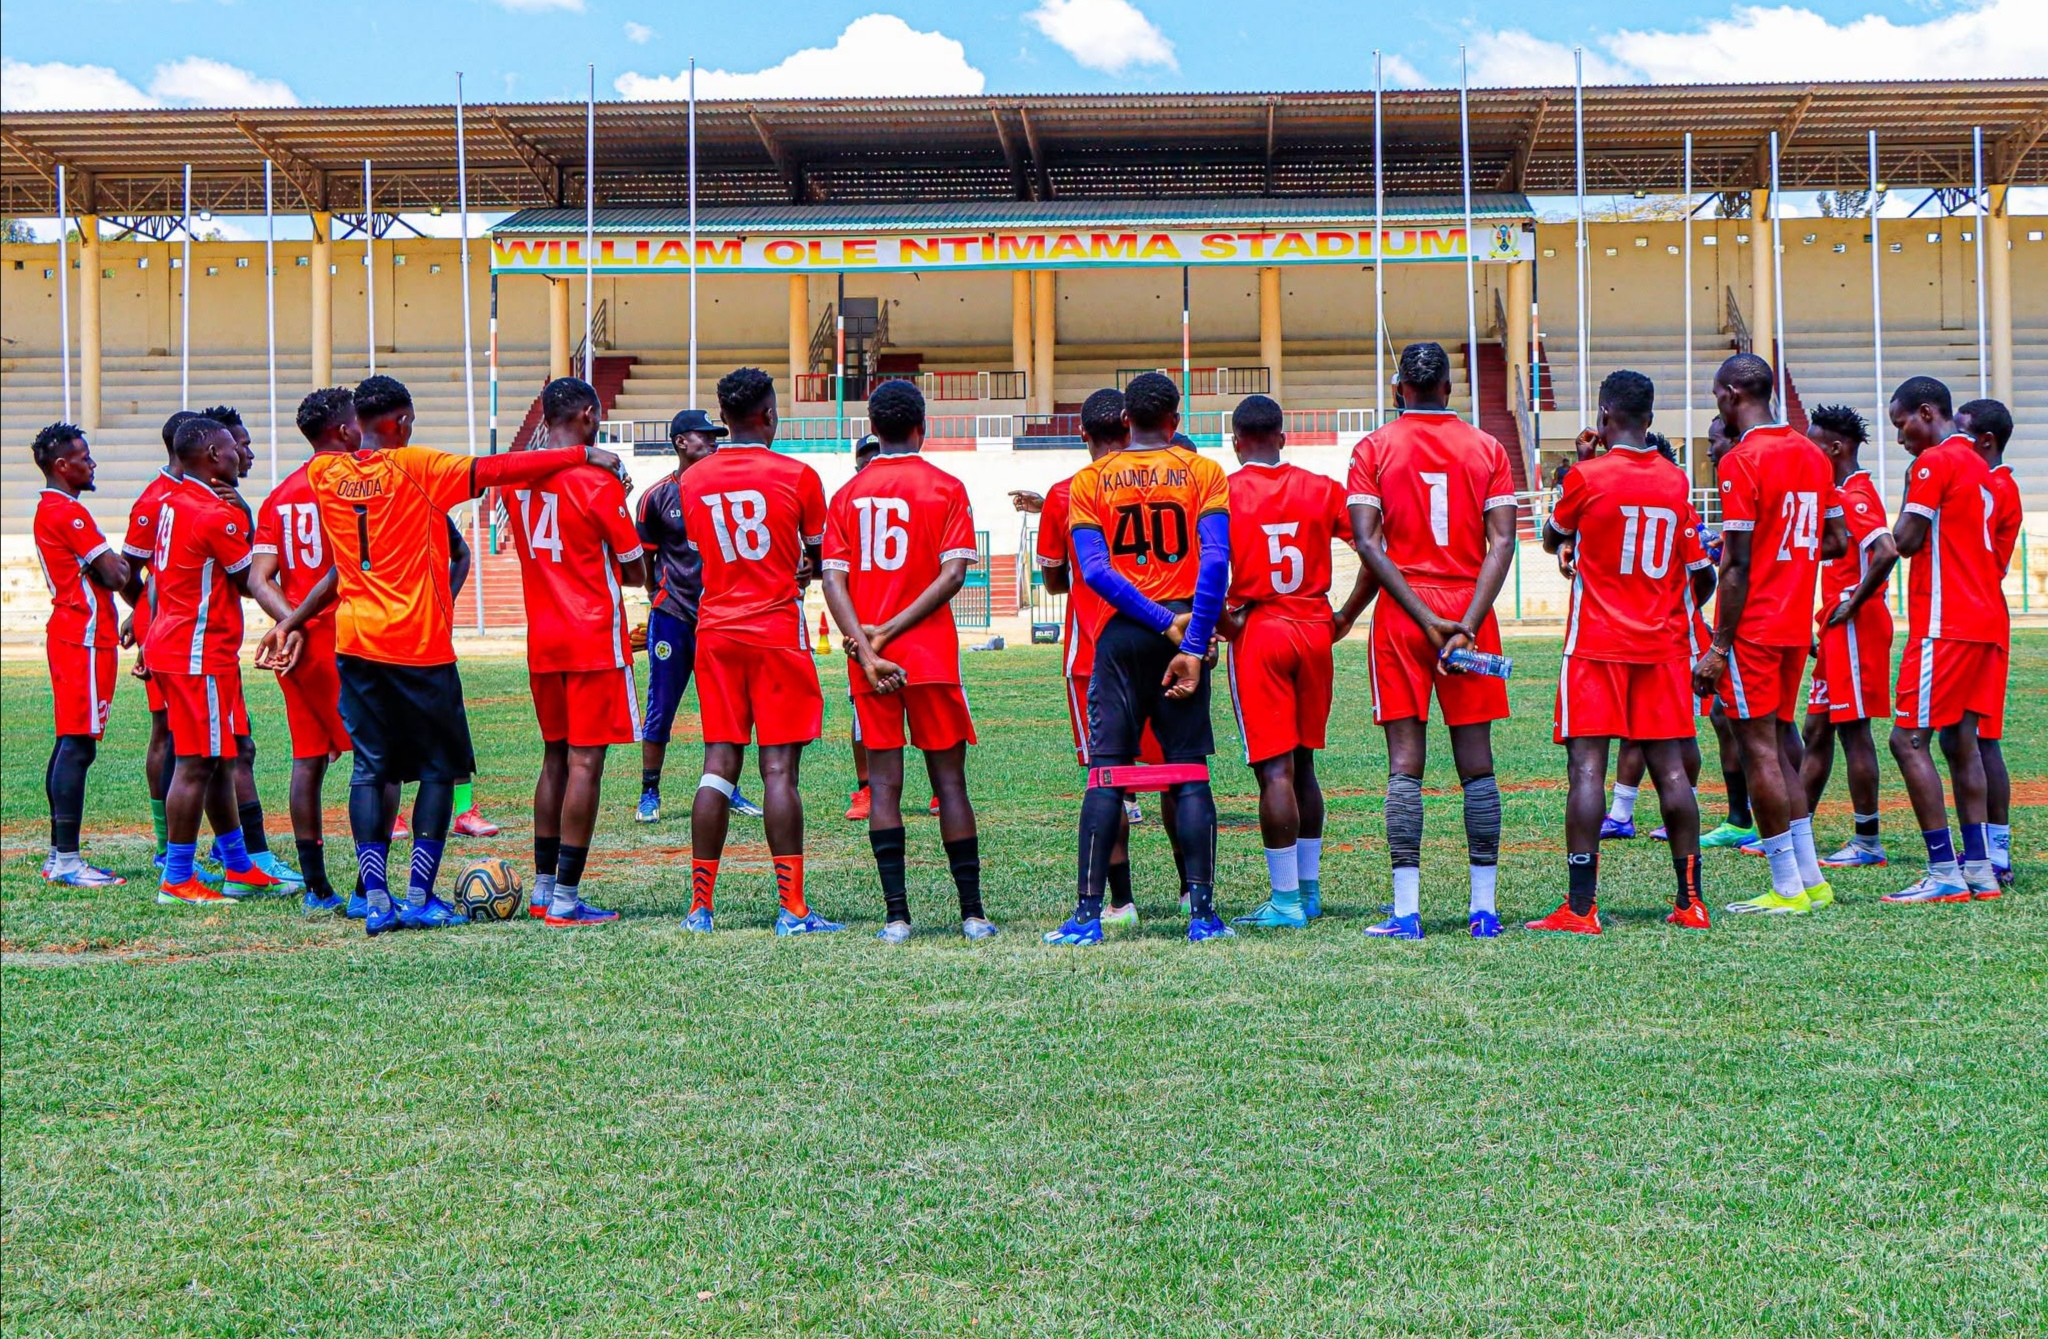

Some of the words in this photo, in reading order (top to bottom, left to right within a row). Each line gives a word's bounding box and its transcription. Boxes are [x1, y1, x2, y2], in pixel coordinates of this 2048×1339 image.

[493, 240, 742, 266] WILLIAM
[763, 239, 878, 266] OLE
[900, 234, 1183, 264] NTIMAMA
[1200, 228, 1467, 259] STADIUM
[337, 479, 383, 498] OGENDA
[1103, 469, 1159, 493] KAUNDA
[1163, 469, 1189, 487] JNR
[1419, 472, 1449, 547] 1
[276, 502, 323, 570] 19
[352, 504, 371, 571] 1
[514, 489, 564, 563] 14
[700, 490, 771, 563] 18
[852, 496, 910, 571] 16
[1112, 502, 1189, 565] 40
[1261, 521, 1304, 594] 5
[1619, 505, 1678, 579] 10
[1776, 491, 1819, 561] 24
